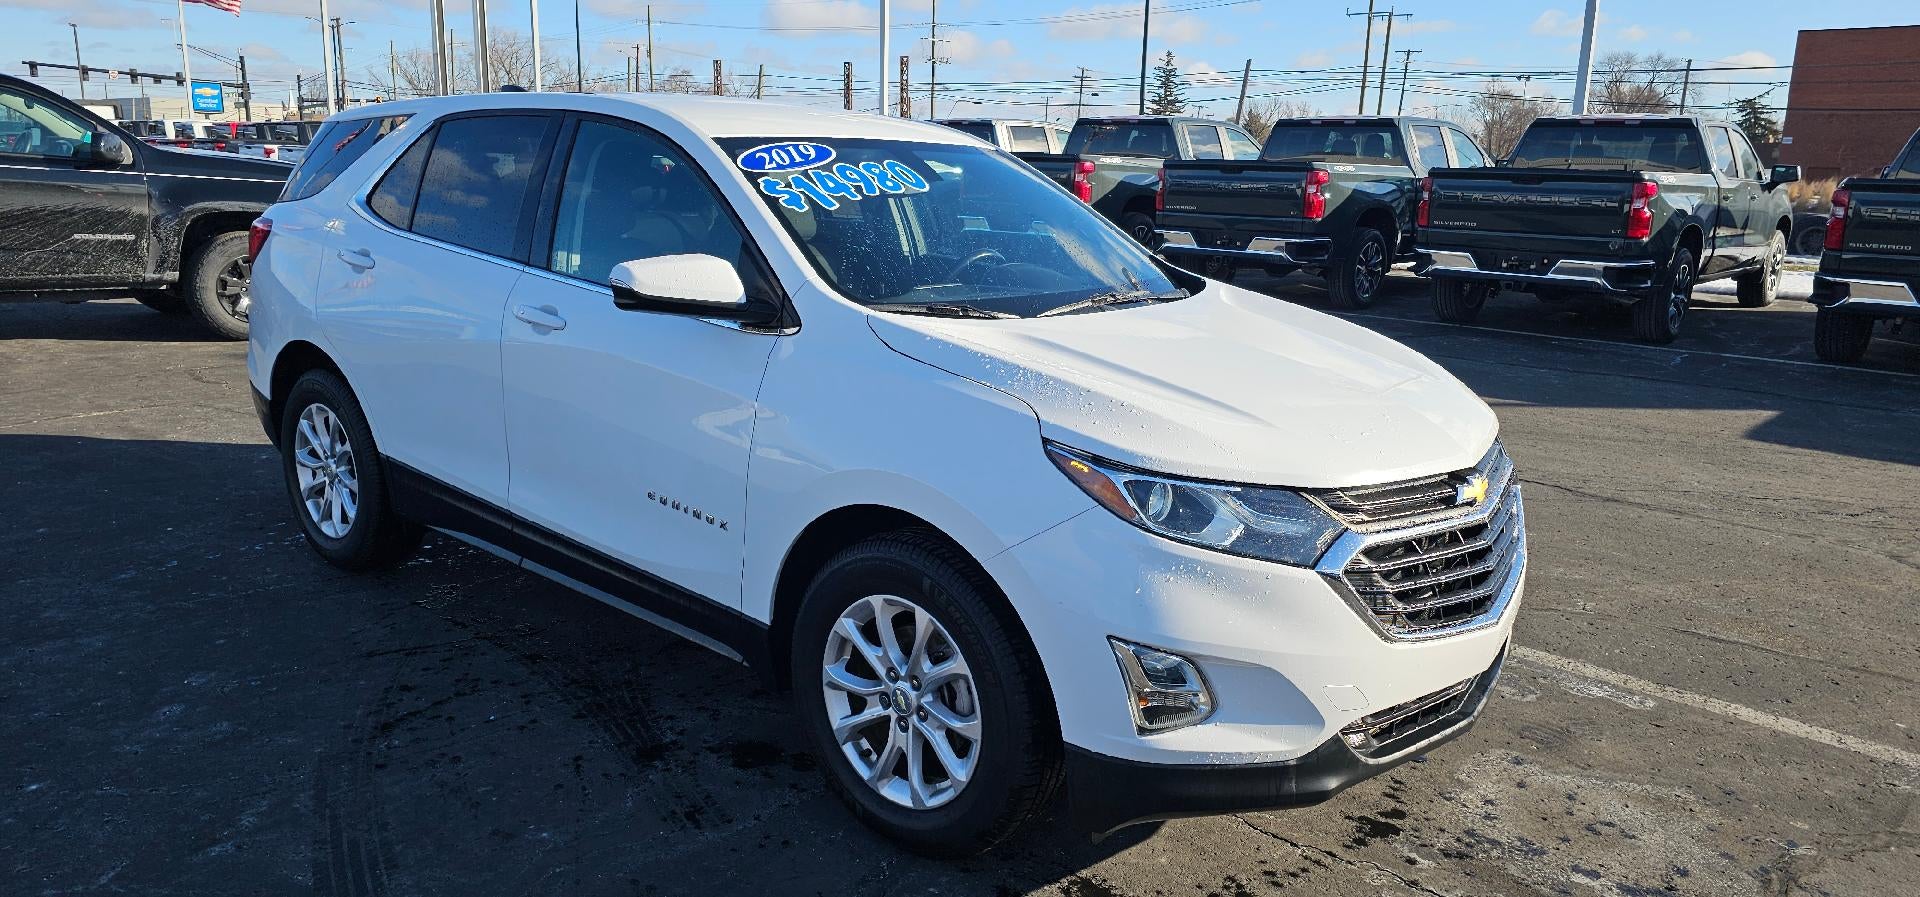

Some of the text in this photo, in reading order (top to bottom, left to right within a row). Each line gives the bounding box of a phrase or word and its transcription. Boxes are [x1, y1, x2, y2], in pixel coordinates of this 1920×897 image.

[755, 144, 816, 170] 2019
[756, 159, 931, 213] $14980
[1849, 242, 1912, 251] SILVERADO
[647, 490, 729, 531] EQUINOX
